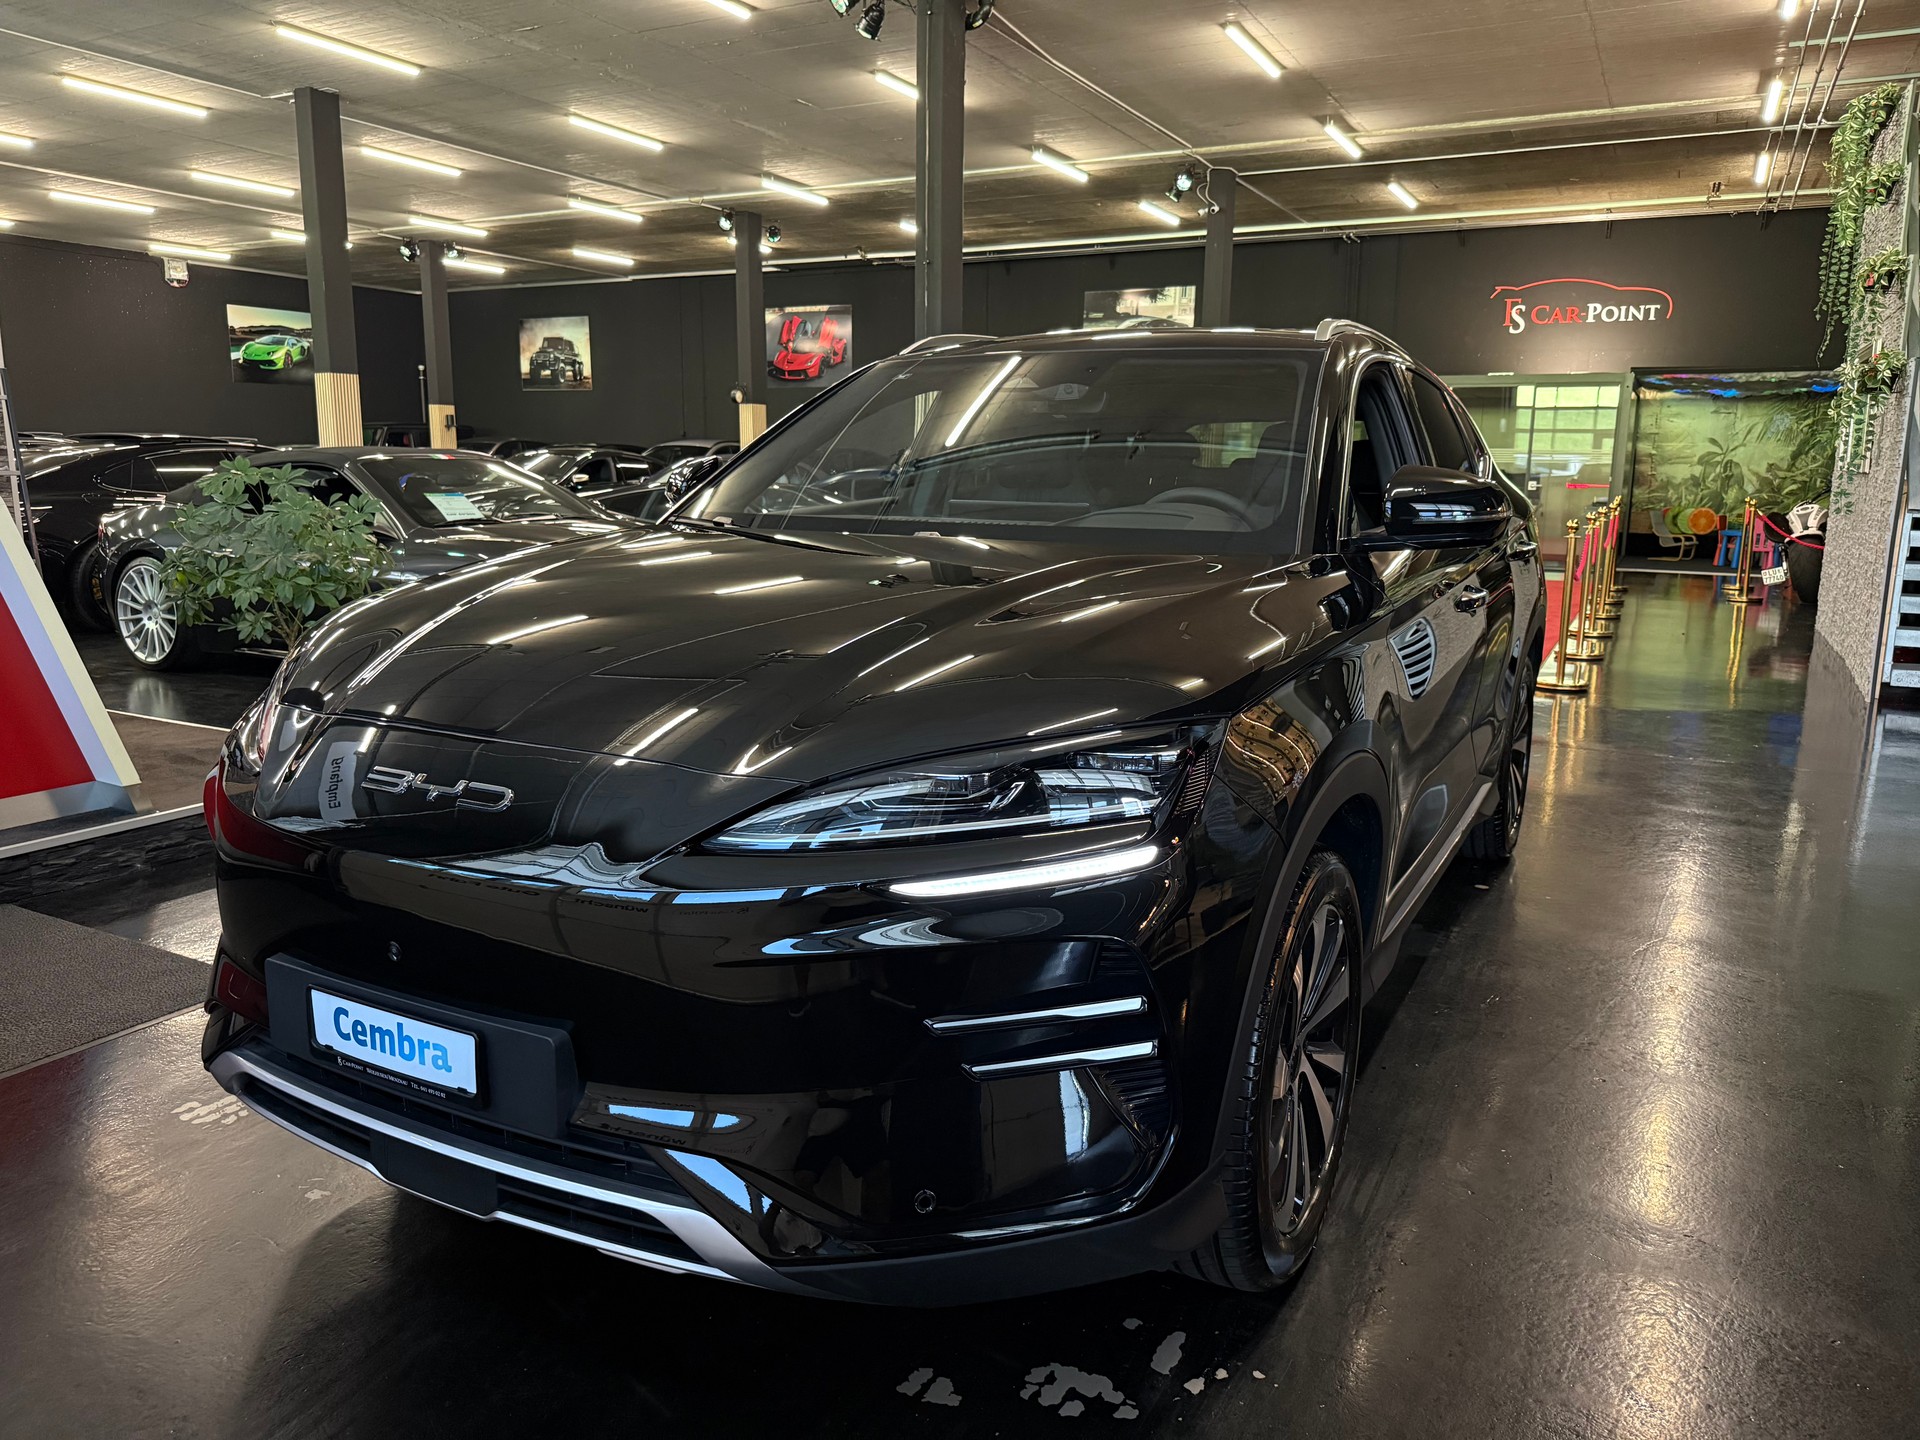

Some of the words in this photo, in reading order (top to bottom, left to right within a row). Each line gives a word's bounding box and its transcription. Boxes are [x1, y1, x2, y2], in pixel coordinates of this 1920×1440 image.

[1530, 303, 1661, 325] CAR-POINT
[361, 765, 515, 813] BYD
[333, 1006, 453, 1073] Cembra
